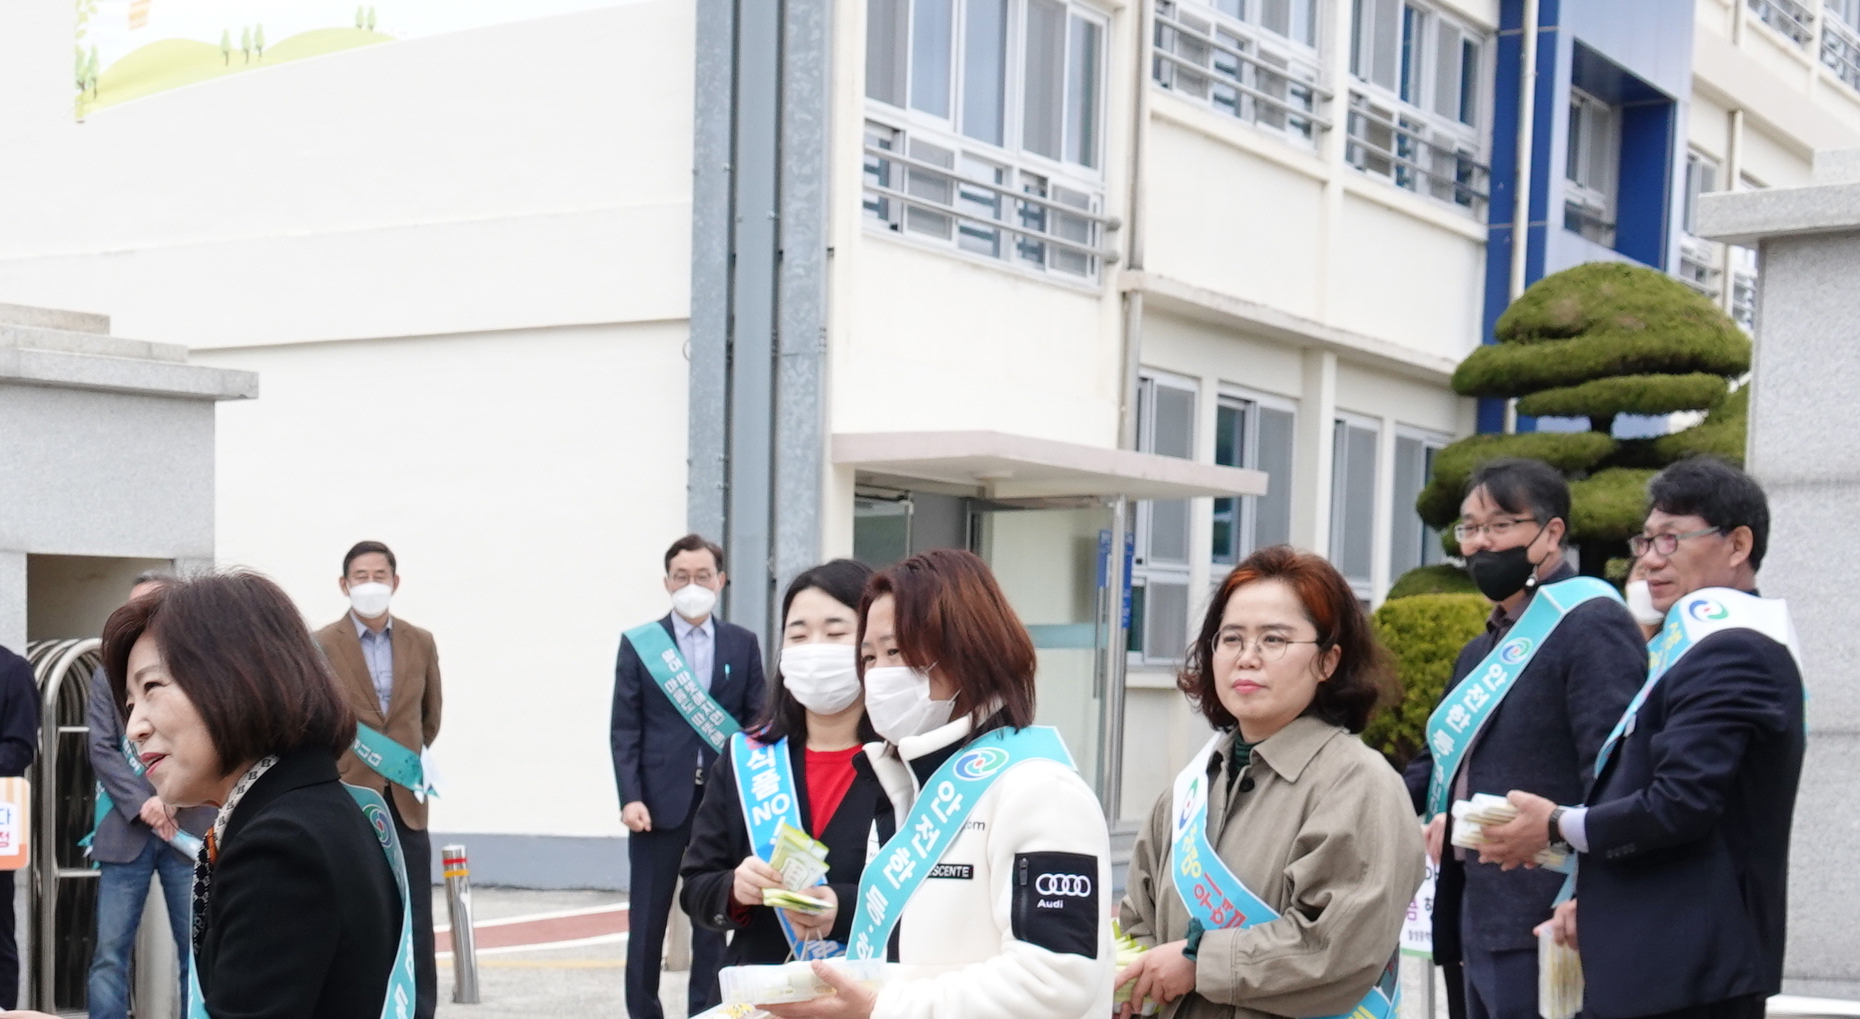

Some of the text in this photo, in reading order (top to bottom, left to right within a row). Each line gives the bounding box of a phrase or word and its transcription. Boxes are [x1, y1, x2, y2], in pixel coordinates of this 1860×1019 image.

[1446, 663, 1508, 733] 안전한
[746, 744, 781, 801] 식품
[883, 781, 963, 889] 안전한
[1037, 898, 1064, 909] Audi
